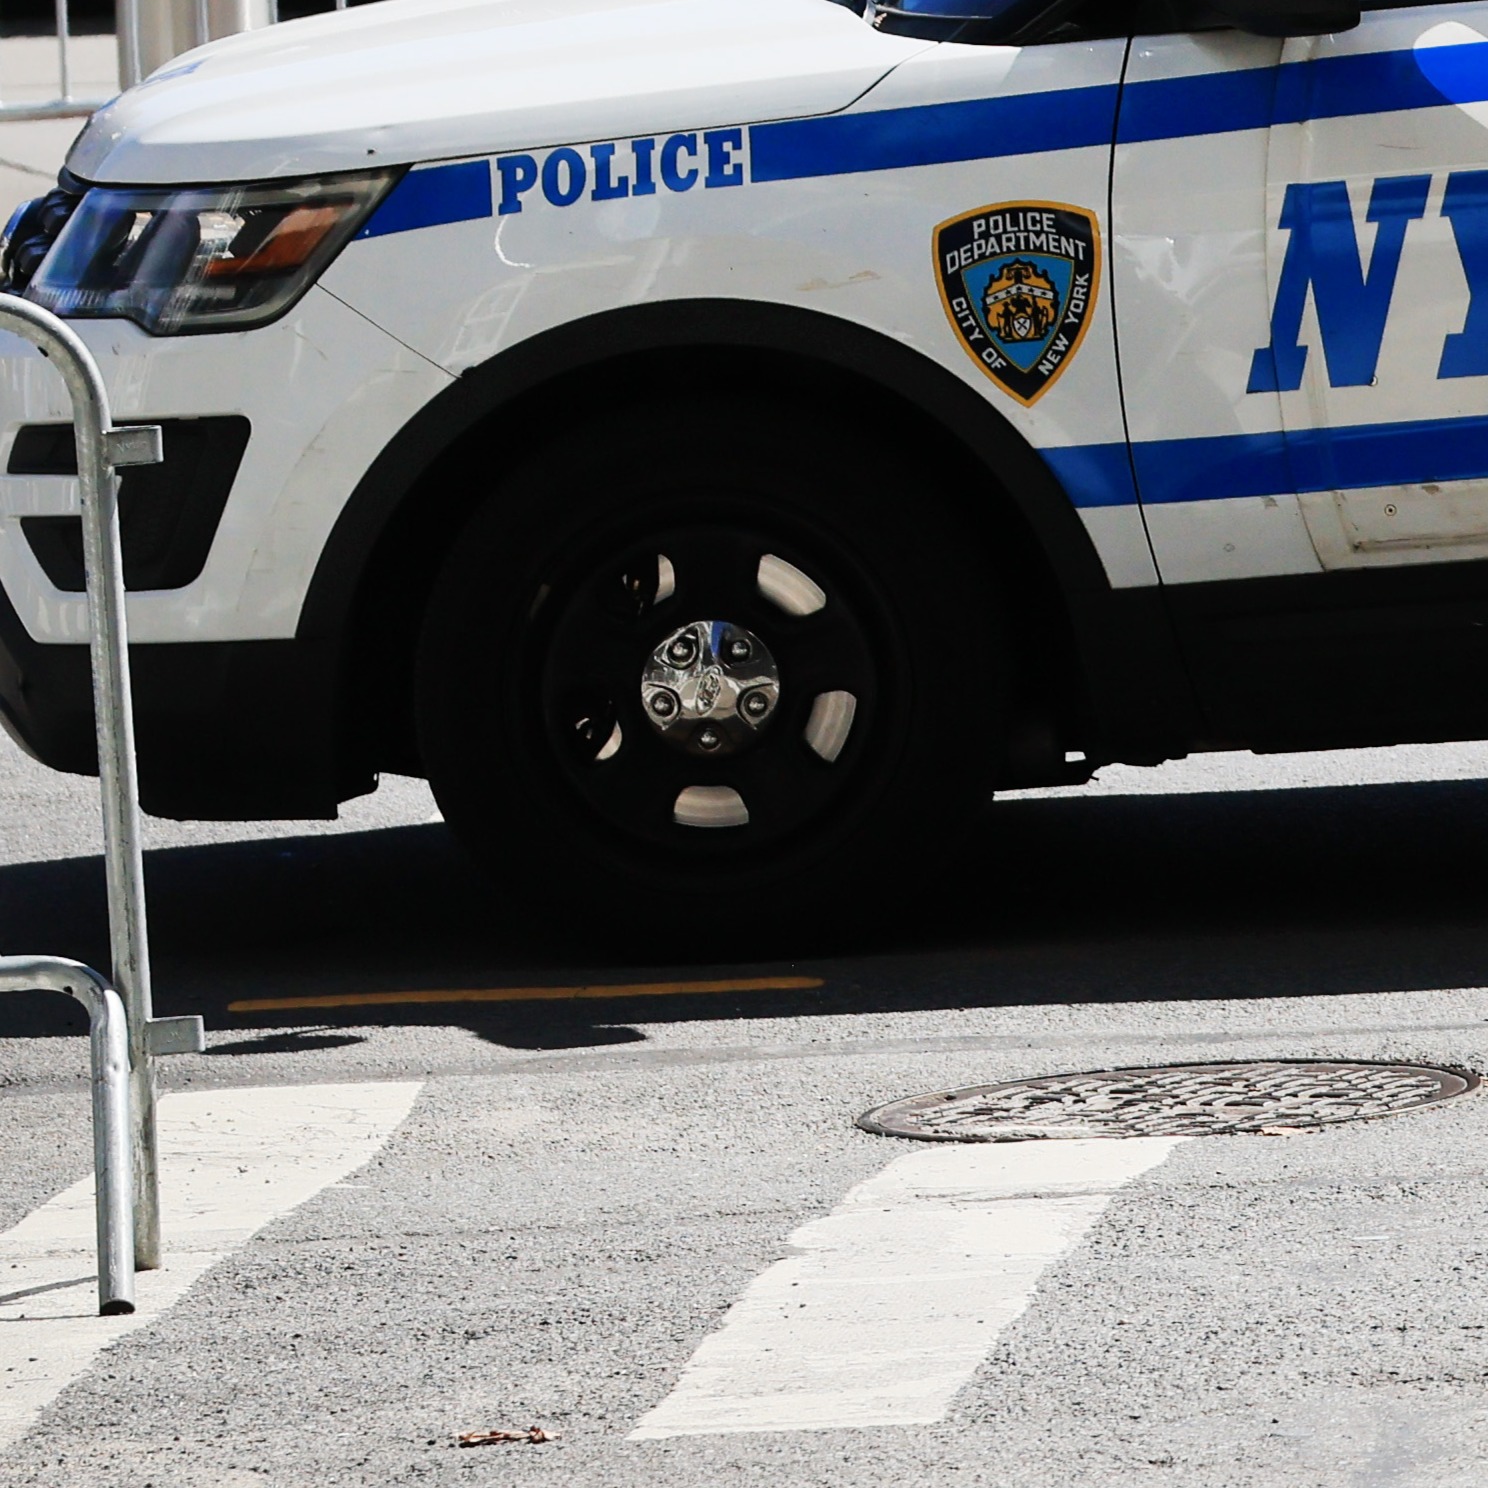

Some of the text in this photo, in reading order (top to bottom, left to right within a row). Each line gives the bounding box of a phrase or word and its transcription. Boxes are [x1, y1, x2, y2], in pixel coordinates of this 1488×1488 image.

[496, 128, 743, 216] POLICE
[945, 232, 1087, 275] DEPARTMENT
[972, 211, 1056, 240] POLICE
[952, 272, 1090, 376] CITY OF NEW YORK
